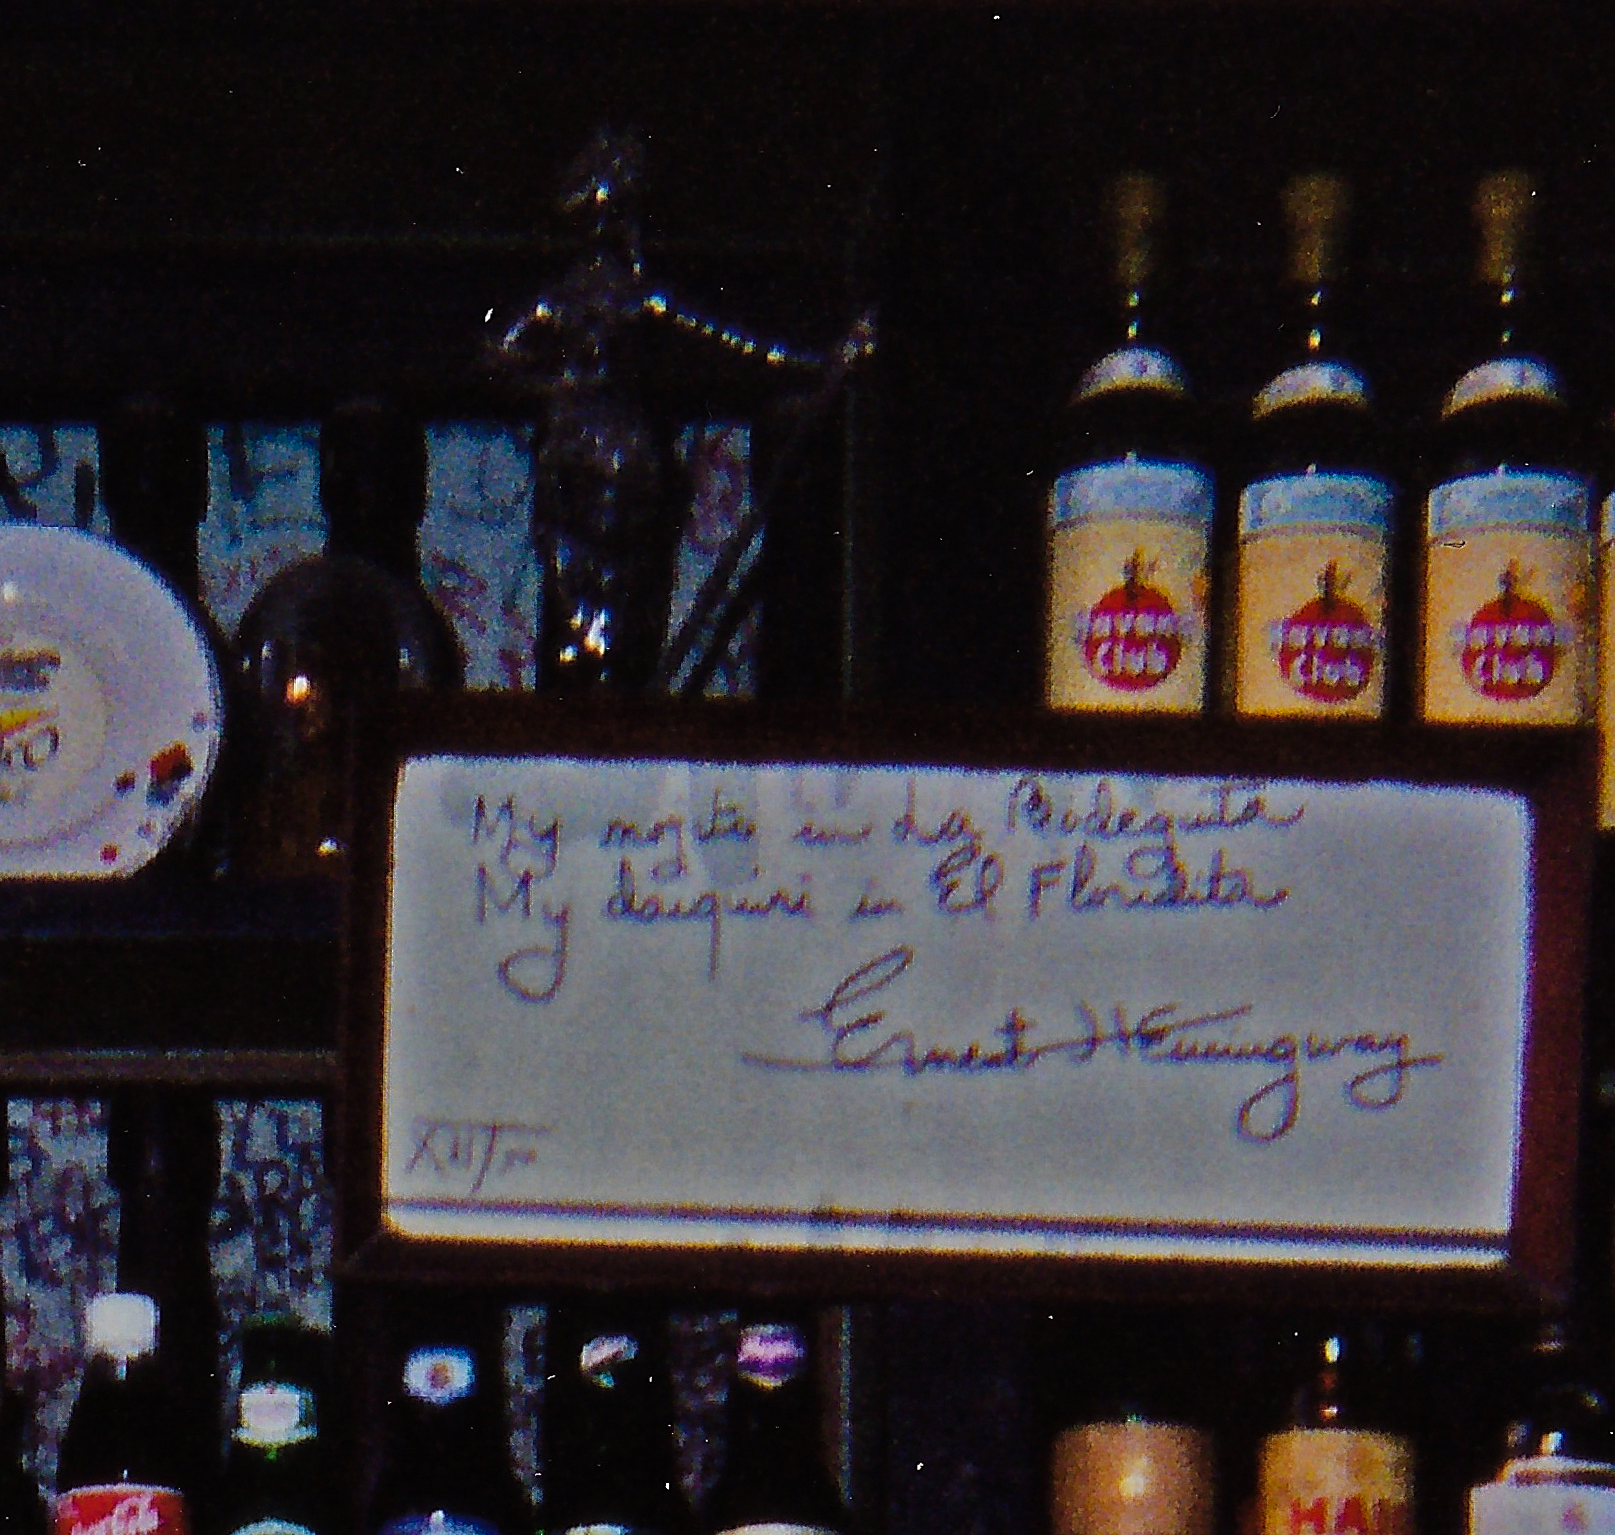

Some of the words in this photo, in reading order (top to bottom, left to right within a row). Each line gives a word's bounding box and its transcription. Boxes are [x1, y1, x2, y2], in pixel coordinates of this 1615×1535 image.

[1095, 640, 1170, 675] Club
[1290, 653, 1364, 690] Club
[1472, 652, 1548, 689] Club
[474, 860, 568, 1001] My
